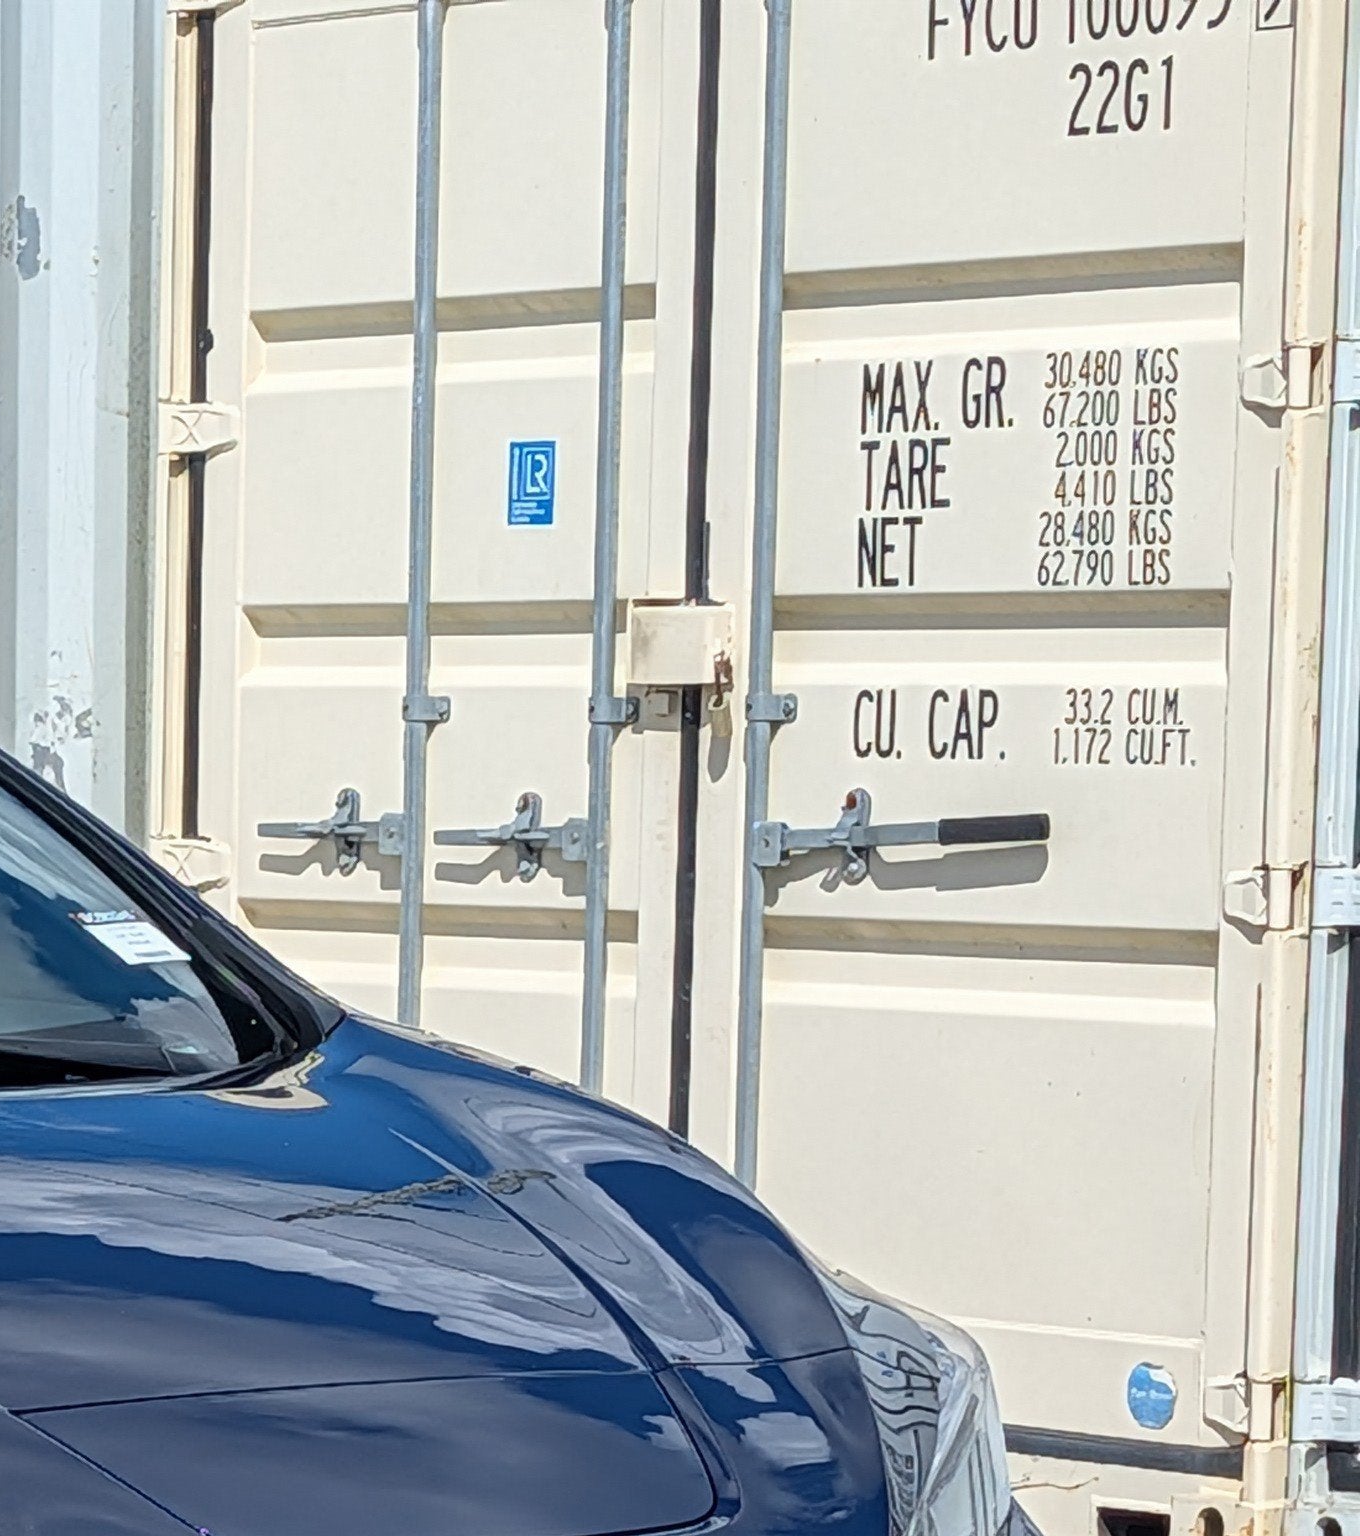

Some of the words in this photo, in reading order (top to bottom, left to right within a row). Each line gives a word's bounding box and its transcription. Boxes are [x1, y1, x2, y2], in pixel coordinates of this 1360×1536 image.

[1068, 54, 1174, 136] 22G1
[860, 359, 940, 435] MAX.
[961, 355, 1015, 429] GR.
[1135, 347, 1179, 385] KGS
[1133, 387, 1178, 426] LBS
[860, 437, 951, 511] TARE
[1131, 427, 1176, 466] KGS
[1129, 467, 1174, 505] LBS
[857, 516, 923, 588] NET
[1128, 508, 1173, 545] KGS
[1127, 548, 1171, 586] LBS
[853, 688, 902, 760] CU.
[928, 688, 1006, 760] CAP.
[1064, 687, 1114, 725] 33.2
